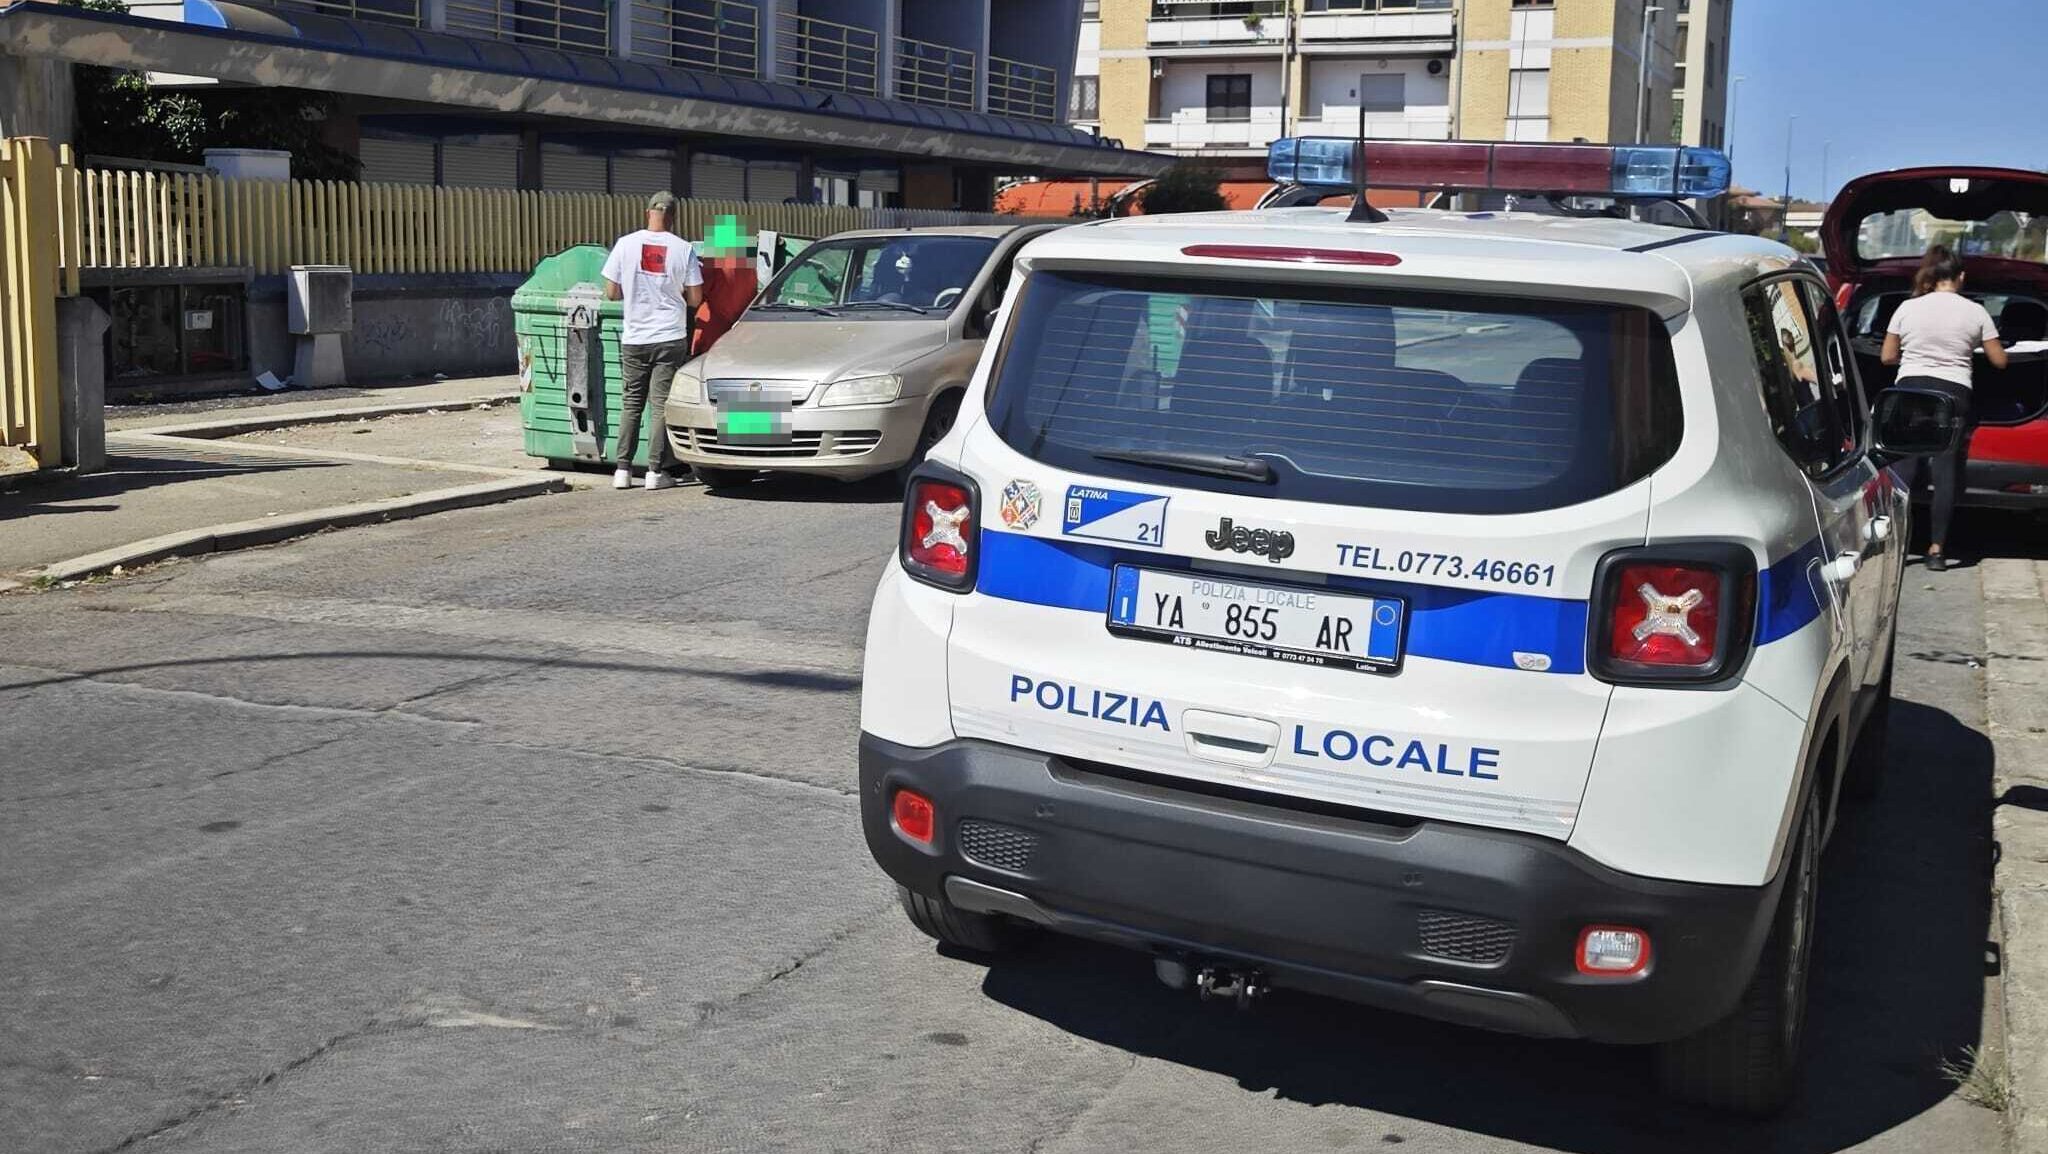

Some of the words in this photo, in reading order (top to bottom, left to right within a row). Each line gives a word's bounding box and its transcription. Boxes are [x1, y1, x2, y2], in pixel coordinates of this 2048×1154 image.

[1070, 487, 1109, 500] LATINA
[1137, 522, 1161, 543] 21
[1205, 517, 1295, 563] Jeep
[1336, 544, 1555, 587] TEL.0773.46661
[1191, 581, 1246, 601] POLIZIA
[1256, 586, 1317, 610] LOCALE
[1155, 592, 1184, 629] YA
[1225, 603, 1279, 641] 855
[1315, 615, 1354, 652] AR
[1173, 635, 1192, 646] ATS
[1011, 674, 1171, 732] POLIZIA
[1293, 724, 1500, 780] LOCALE
